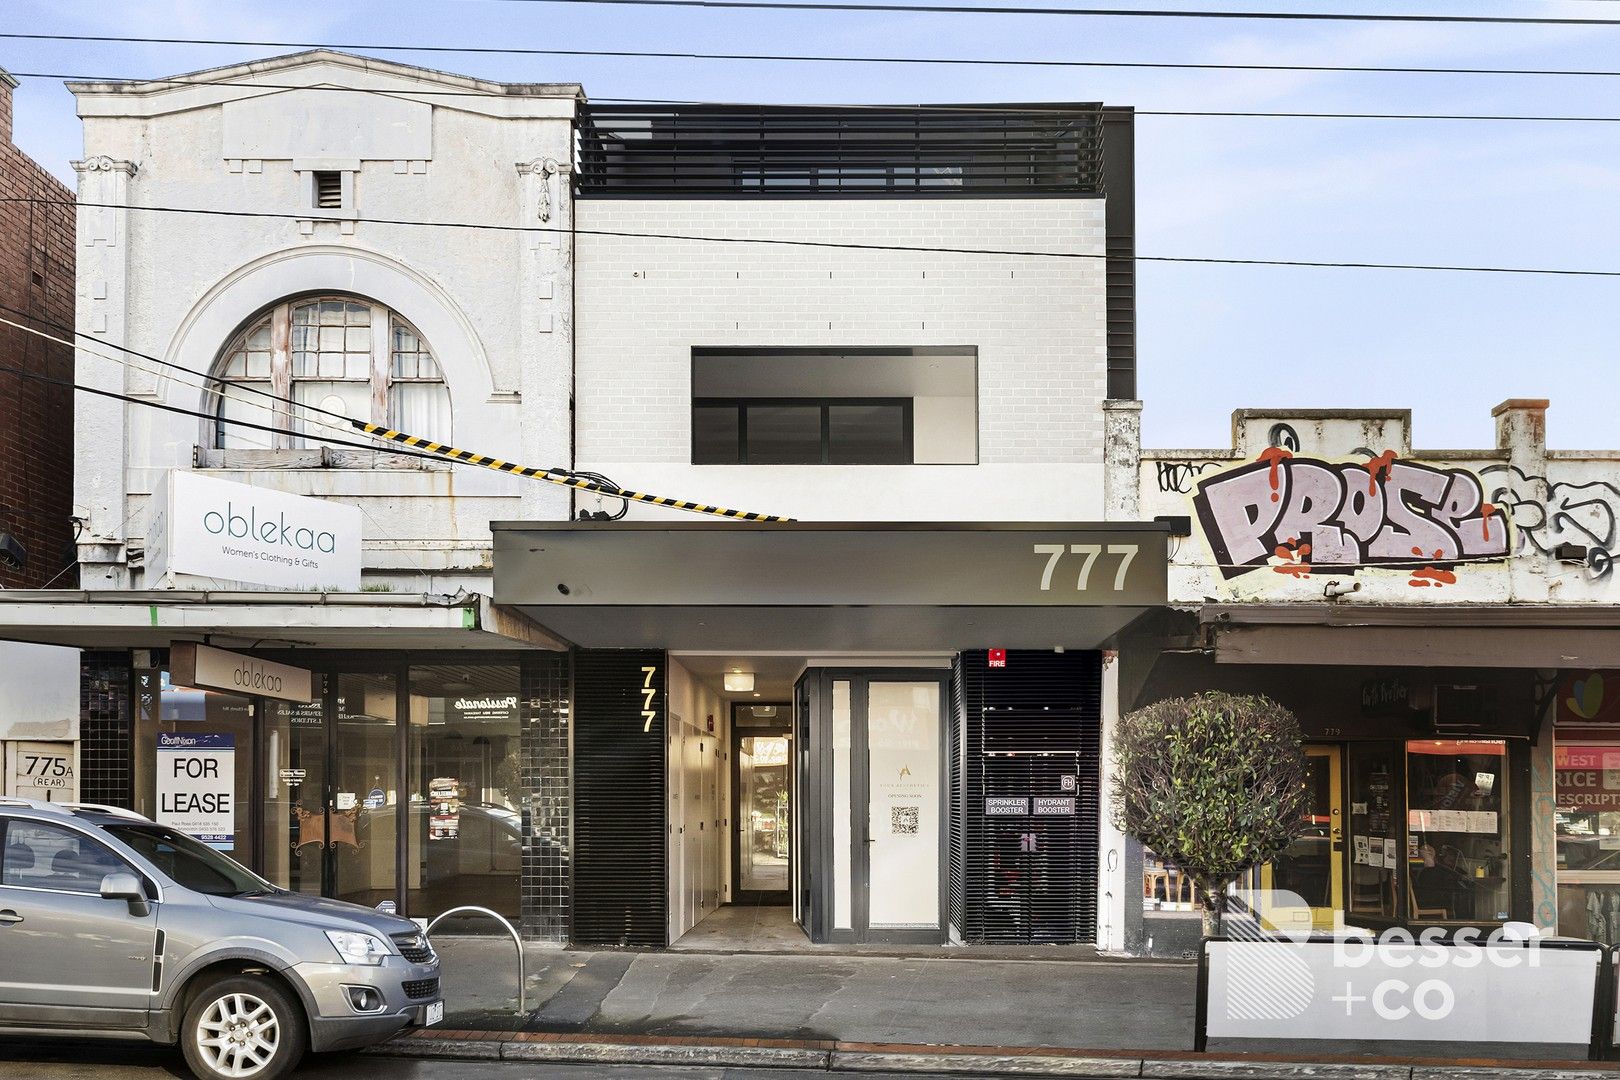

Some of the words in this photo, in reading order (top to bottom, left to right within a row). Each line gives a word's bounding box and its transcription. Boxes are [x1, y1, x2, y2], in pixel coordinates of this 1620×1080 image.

[203, 501, 336, 554] oblekaa
[221, 545, 259, 560] Women's
[260, 551, 293, 567] Clothing
[294, 557, 301, 566] &
[301, 558, 319, 570] Gifts
[1033, 544, 1139, 591] 777
[988, 660, 1006, 668] FIRE
[233, 660, 283, 693] oblekaa
[641, 666, 657, 733] 777
[1324, 728, 1342, 736] 779
[173, 757, 219, 779] FOR
[33, 777, 66, 788] (REAR)
[161, 792, 230, 814] LEASE
[990, 806, 1024, 814] BOOSTER
[1038, 806, 1070, 814] BOOSTER
